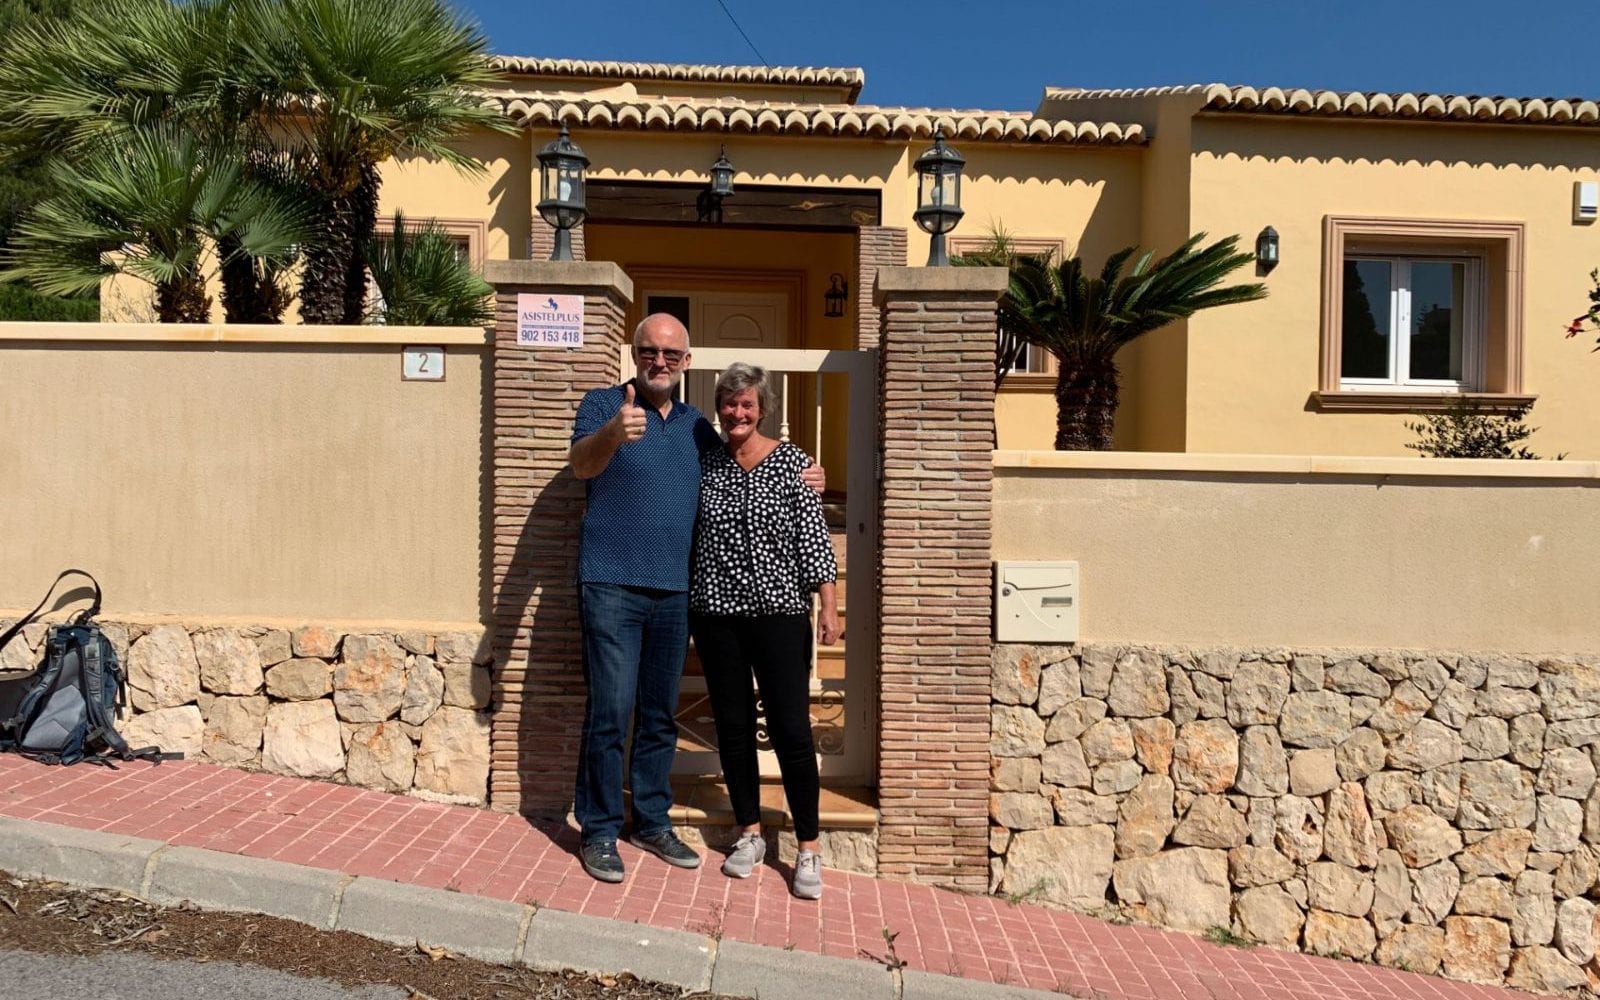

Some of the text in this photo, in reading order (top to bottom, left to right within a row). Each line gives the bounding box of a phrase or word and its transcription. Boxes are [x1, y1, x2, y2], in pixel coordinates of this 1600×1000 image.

[521, 311, 580, 322] ASISTELPLUS
[521, 330, 580, 343] 902 153 418
[419, 352, 429, 373] 2
